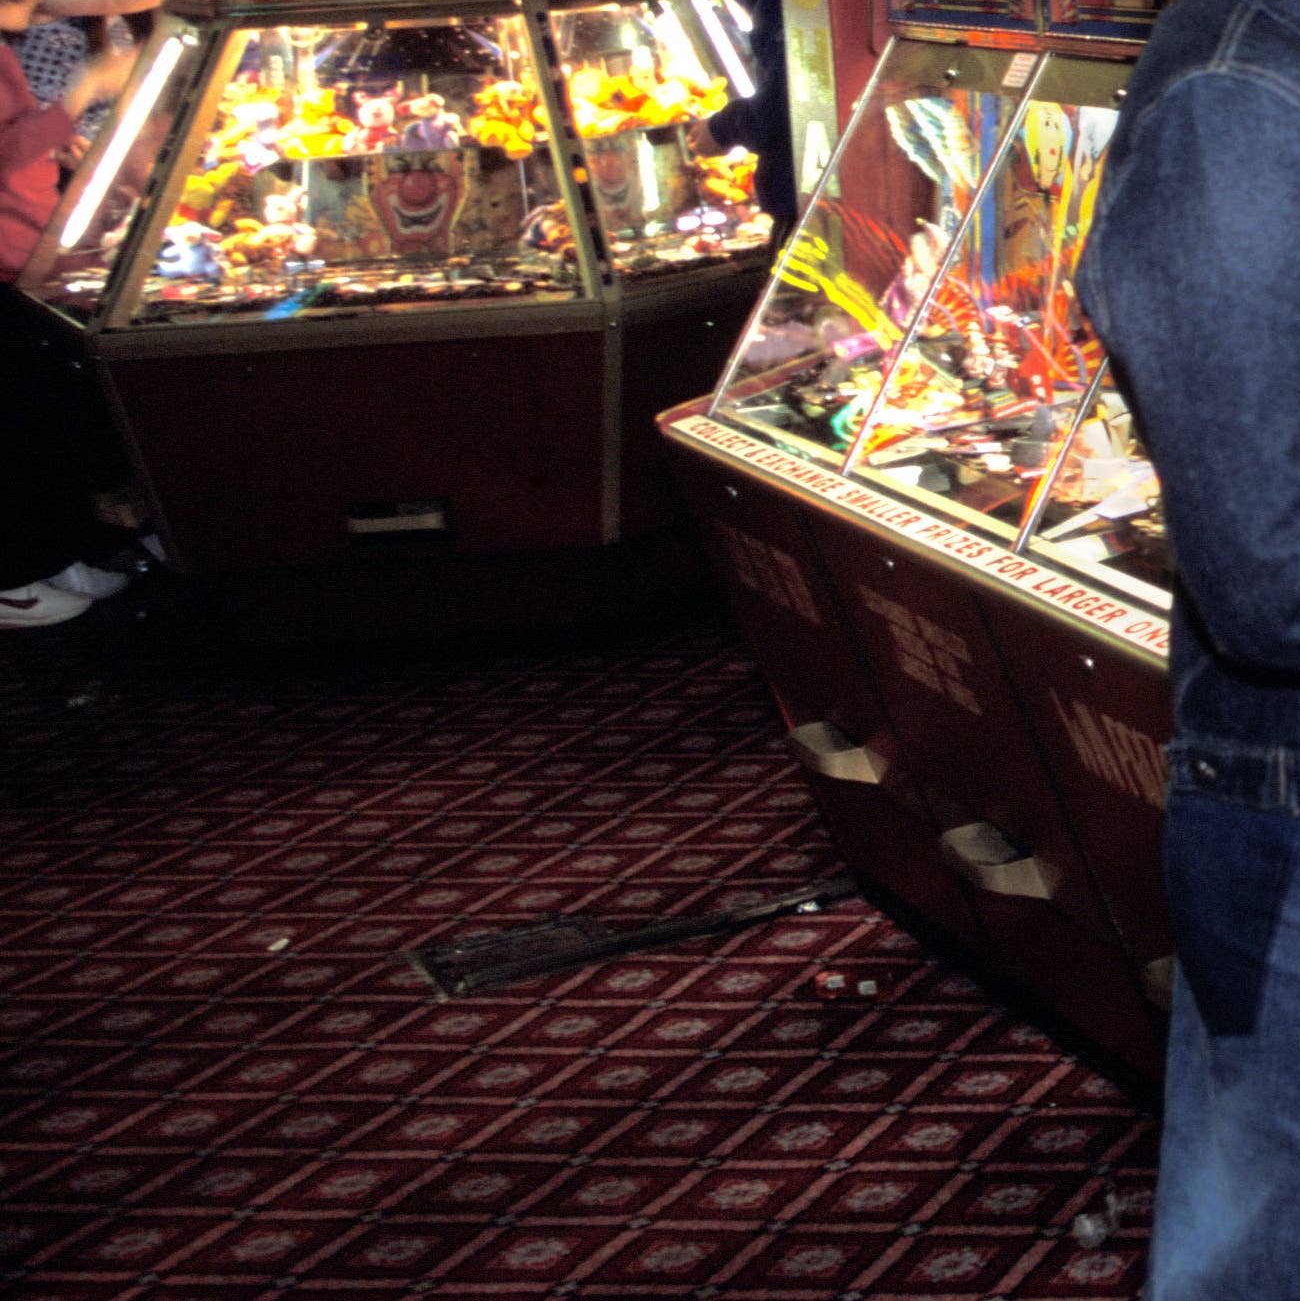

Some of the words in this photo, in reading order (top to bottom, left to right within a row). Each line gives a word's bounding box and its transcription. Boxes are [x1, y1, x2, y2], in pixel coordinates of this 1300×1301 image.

[690, 421, 757, 458] COLLECT
[756, 453, 845, 493] EXCHANGE
[837, 489, 922, 529] SMALLER
[920, 524, 995, 559] PRIZES
[986, 555, 1040, 581] FOR
[1031, 577, 1128, 624] LARGER
